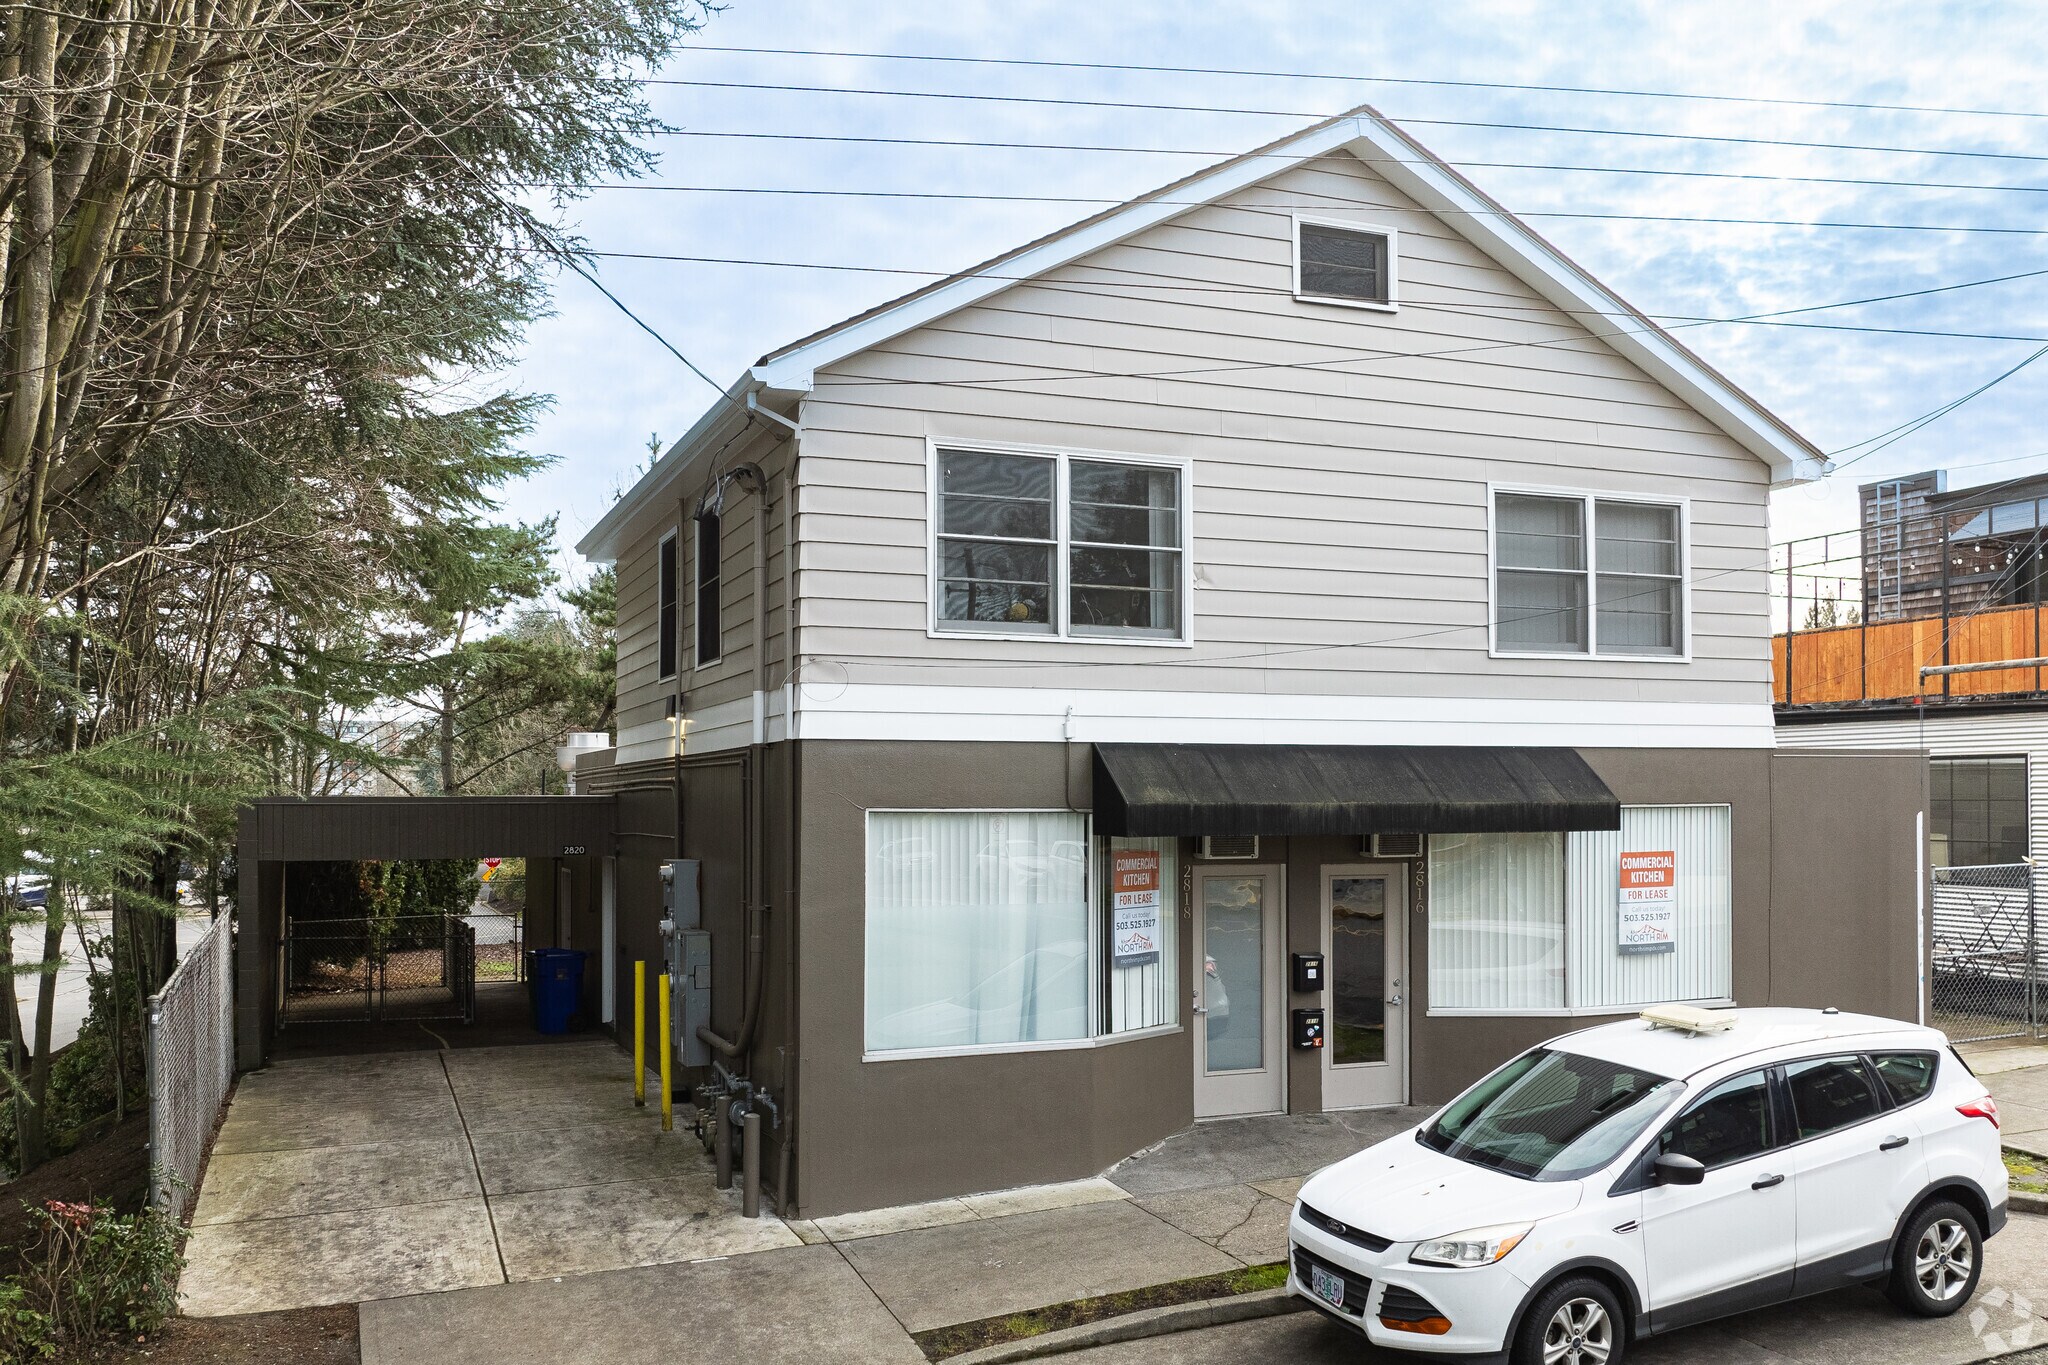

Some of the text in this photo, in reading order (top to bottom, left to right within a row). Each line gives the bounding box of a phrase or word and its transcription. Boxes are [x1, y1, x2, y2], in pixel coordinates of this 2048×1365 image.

[564, 846, 585, 854] 2820
[1116, 858, 1157, 872] COMMERCIAL
[1621, 856, 1673, 869] COMMERCIAL
[1122, 873, 1150, 886] KITCHEN
[1631, 871, 1665, 883] KITCHEN
[1183, 864, 1191, 919] 2818
[1415, 861, 1424, 914] 2816
[1120, 893, 1153, 906] FOR LEASE
[1628, 889, 1669, 900] FOR LEASE
[1624, 912, 1671, 922] 503.525.1927
[1116, 919, 1156, 931] 503.525.1927
[1626, 932, 1669, 943] NORTH RIM
